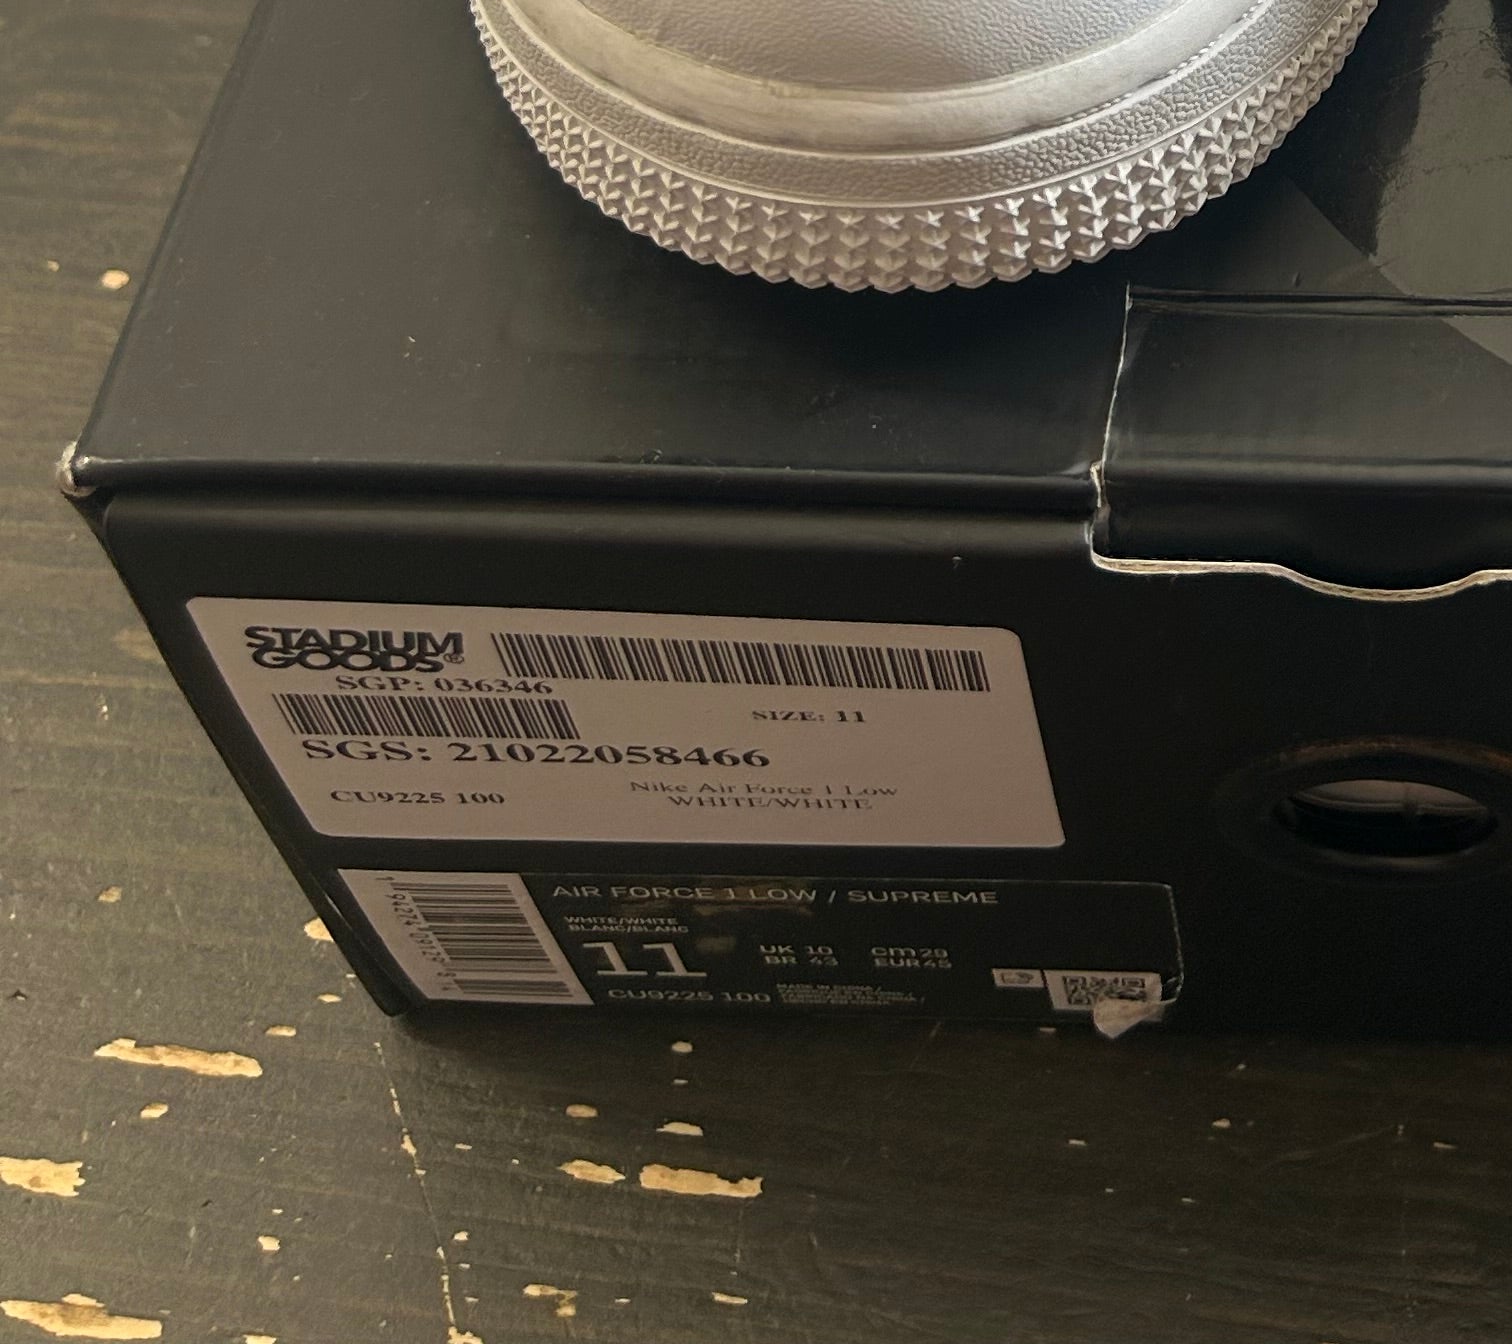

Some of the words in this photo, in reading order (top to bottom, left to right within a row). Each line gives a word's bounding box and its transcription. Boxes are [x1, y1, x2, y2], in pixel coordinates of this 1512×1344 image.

[244, 625, 465, 657] STADIUM
[335, 674, 425, 692] SGP:
[434, 677, 554, 696] 036346
[751, 709, 826, 724] SIZE:
[836, 710, 867, 724] 11
[301, 739, 433, 762] SGS:
[447, 741, 772, 768] 21022058466
[329, 789, 447, 805] CU9225
[457, 791, 506, 805] 100
[629, 781, 689, 795] Nike
[699, 782, 737, 795] Air
[745, 784, 814, 797] Force
[841, 785, 899, 798] Low
[667, 795, 873, 811] WHITE/WHITE
[552, 885, 602, 898] AIR
[609, 886, 713, 900] FORCE
[749, 888, 817, 903] LOW
[847, 890, 999, 905] SUPREME
[759, 944, 795, 955] UK
[582, 941, 708, 978] 11
[607, 988, 714, 1002] CU9225
[719, 990, 772, 1003] 100
